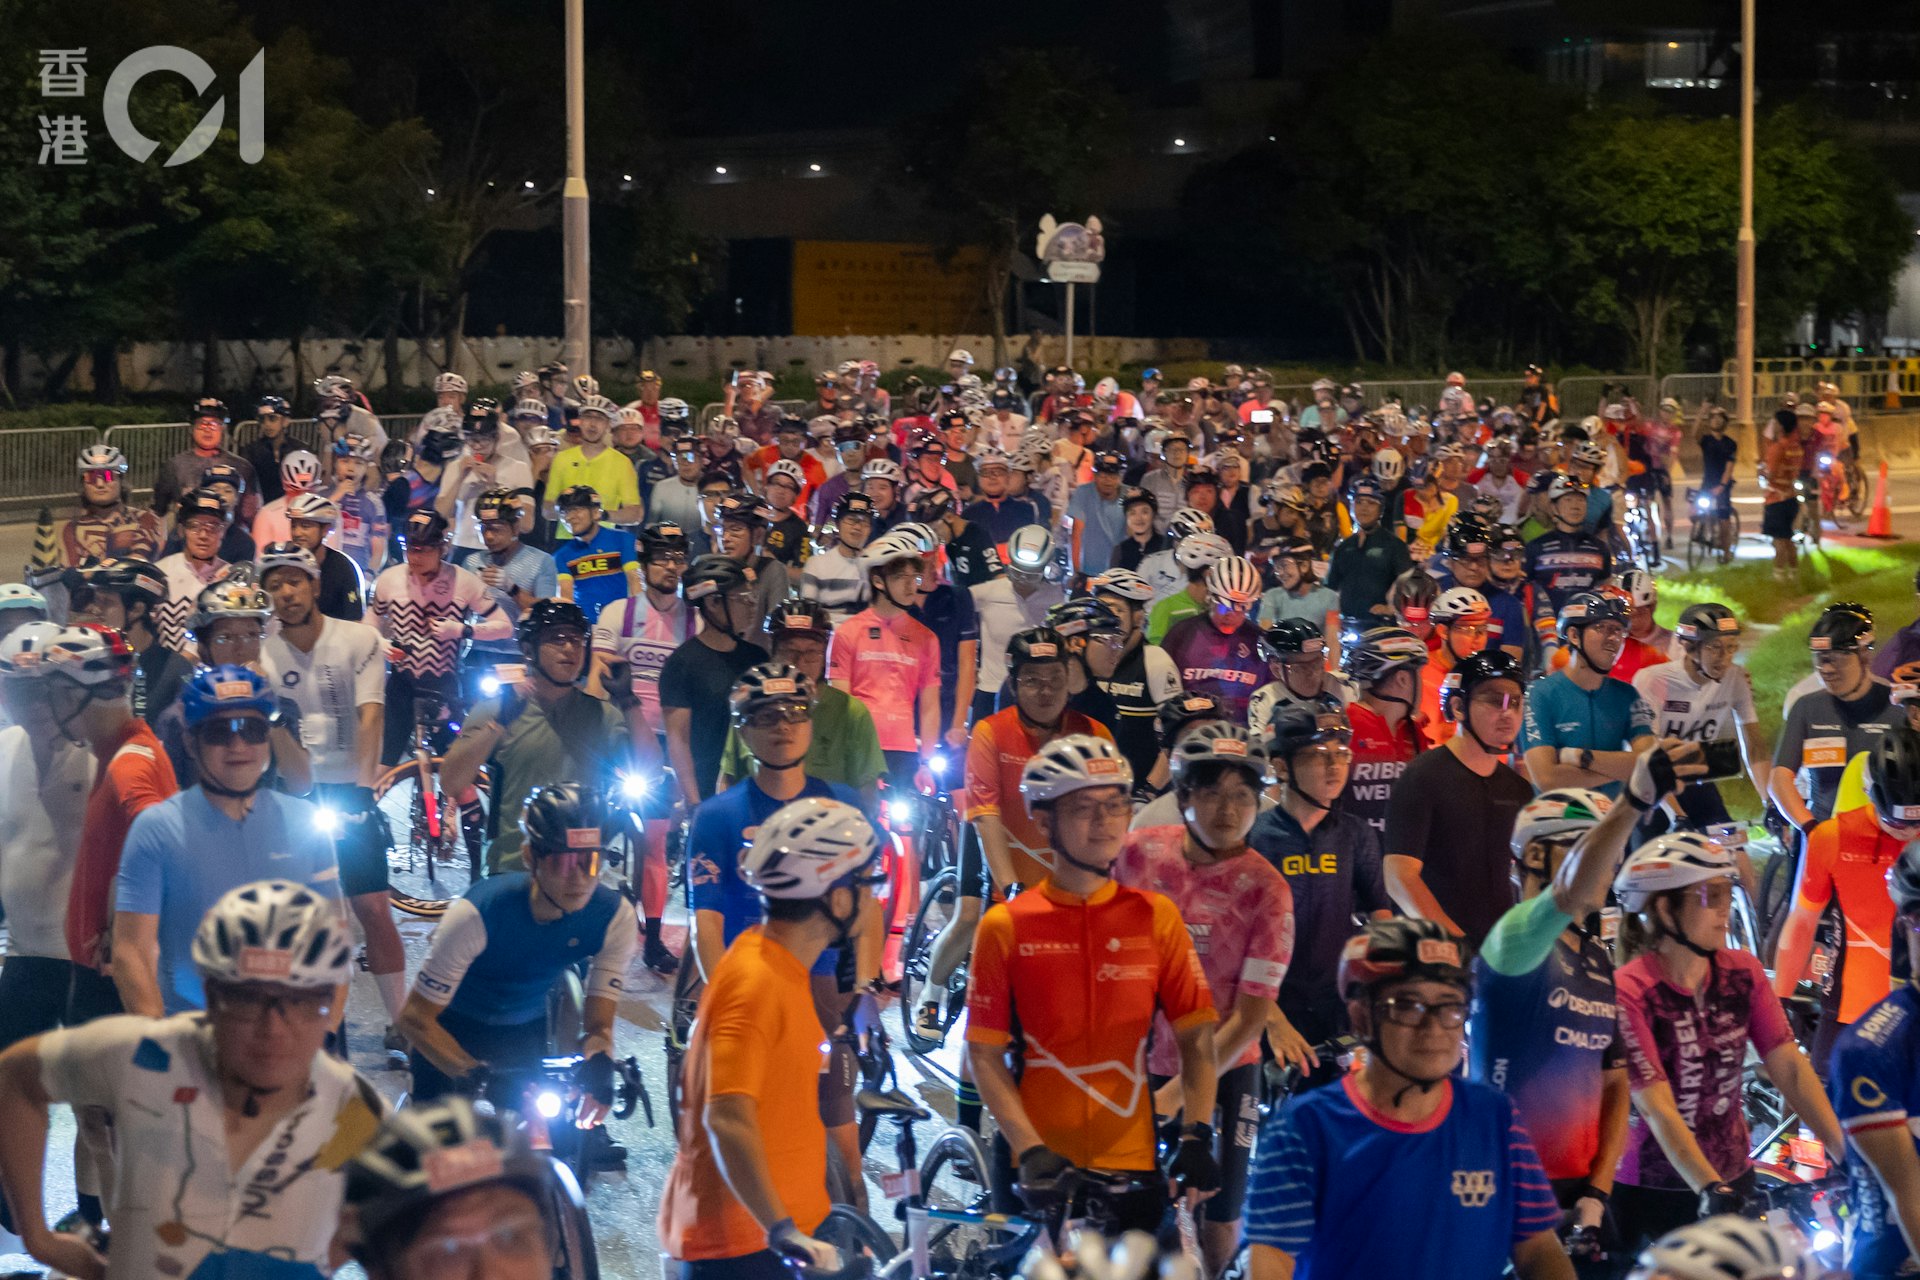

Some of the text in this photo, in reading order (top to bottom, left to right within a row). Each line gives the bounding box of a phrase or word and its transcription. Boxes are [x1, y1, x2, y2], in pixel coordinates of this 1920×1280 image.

[634, 650, 666, 663] COO
[1282, 853, 1337, 876] ALE
[1856, 1002, 1900, 1041] SONIC
[1675, 1011, 1705, 1091] RYSEL
